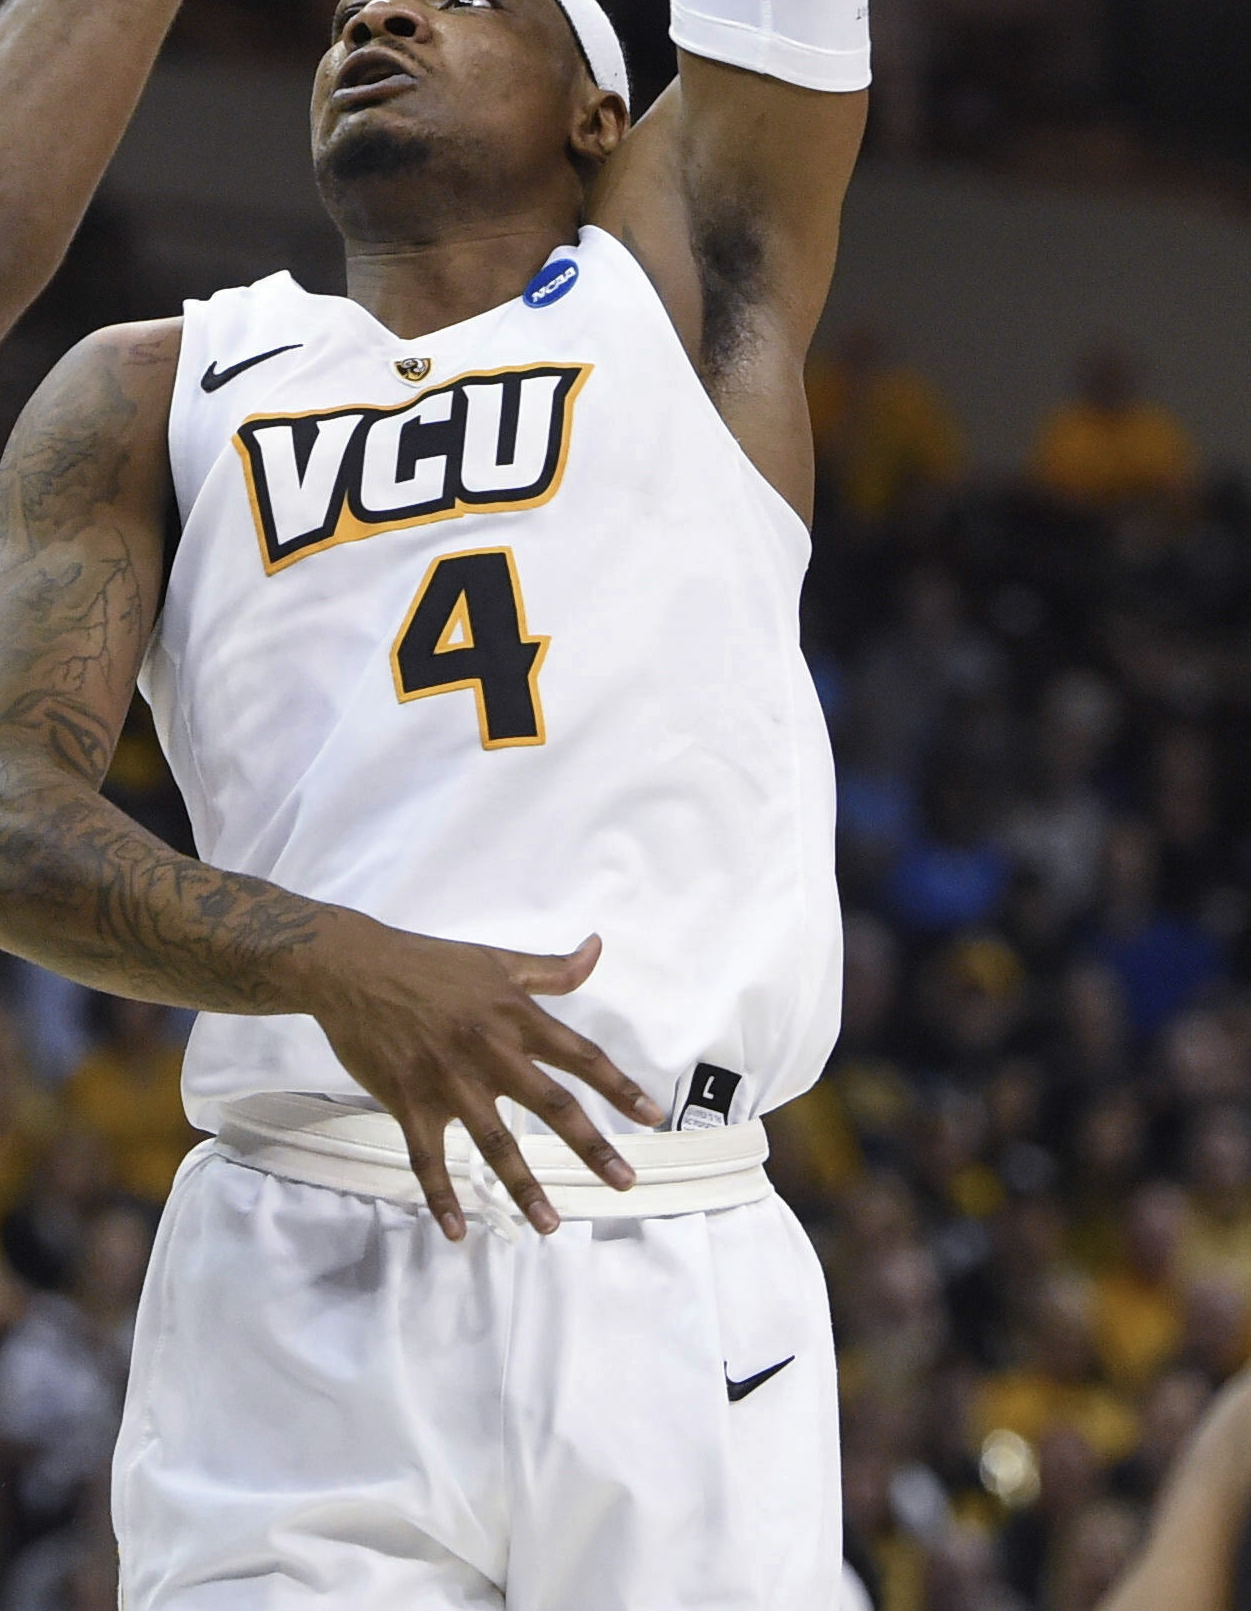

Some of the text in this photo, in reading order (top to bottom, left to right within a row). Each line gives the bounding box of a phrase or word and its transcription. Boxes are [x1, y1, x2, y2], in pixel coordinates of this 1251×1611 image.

[531, 266, 577, 303] NCAA
[235, 365, 590, 571] VCU
[390, 546, 551, 750] 4
[702, 1075, 716, 1100] L
